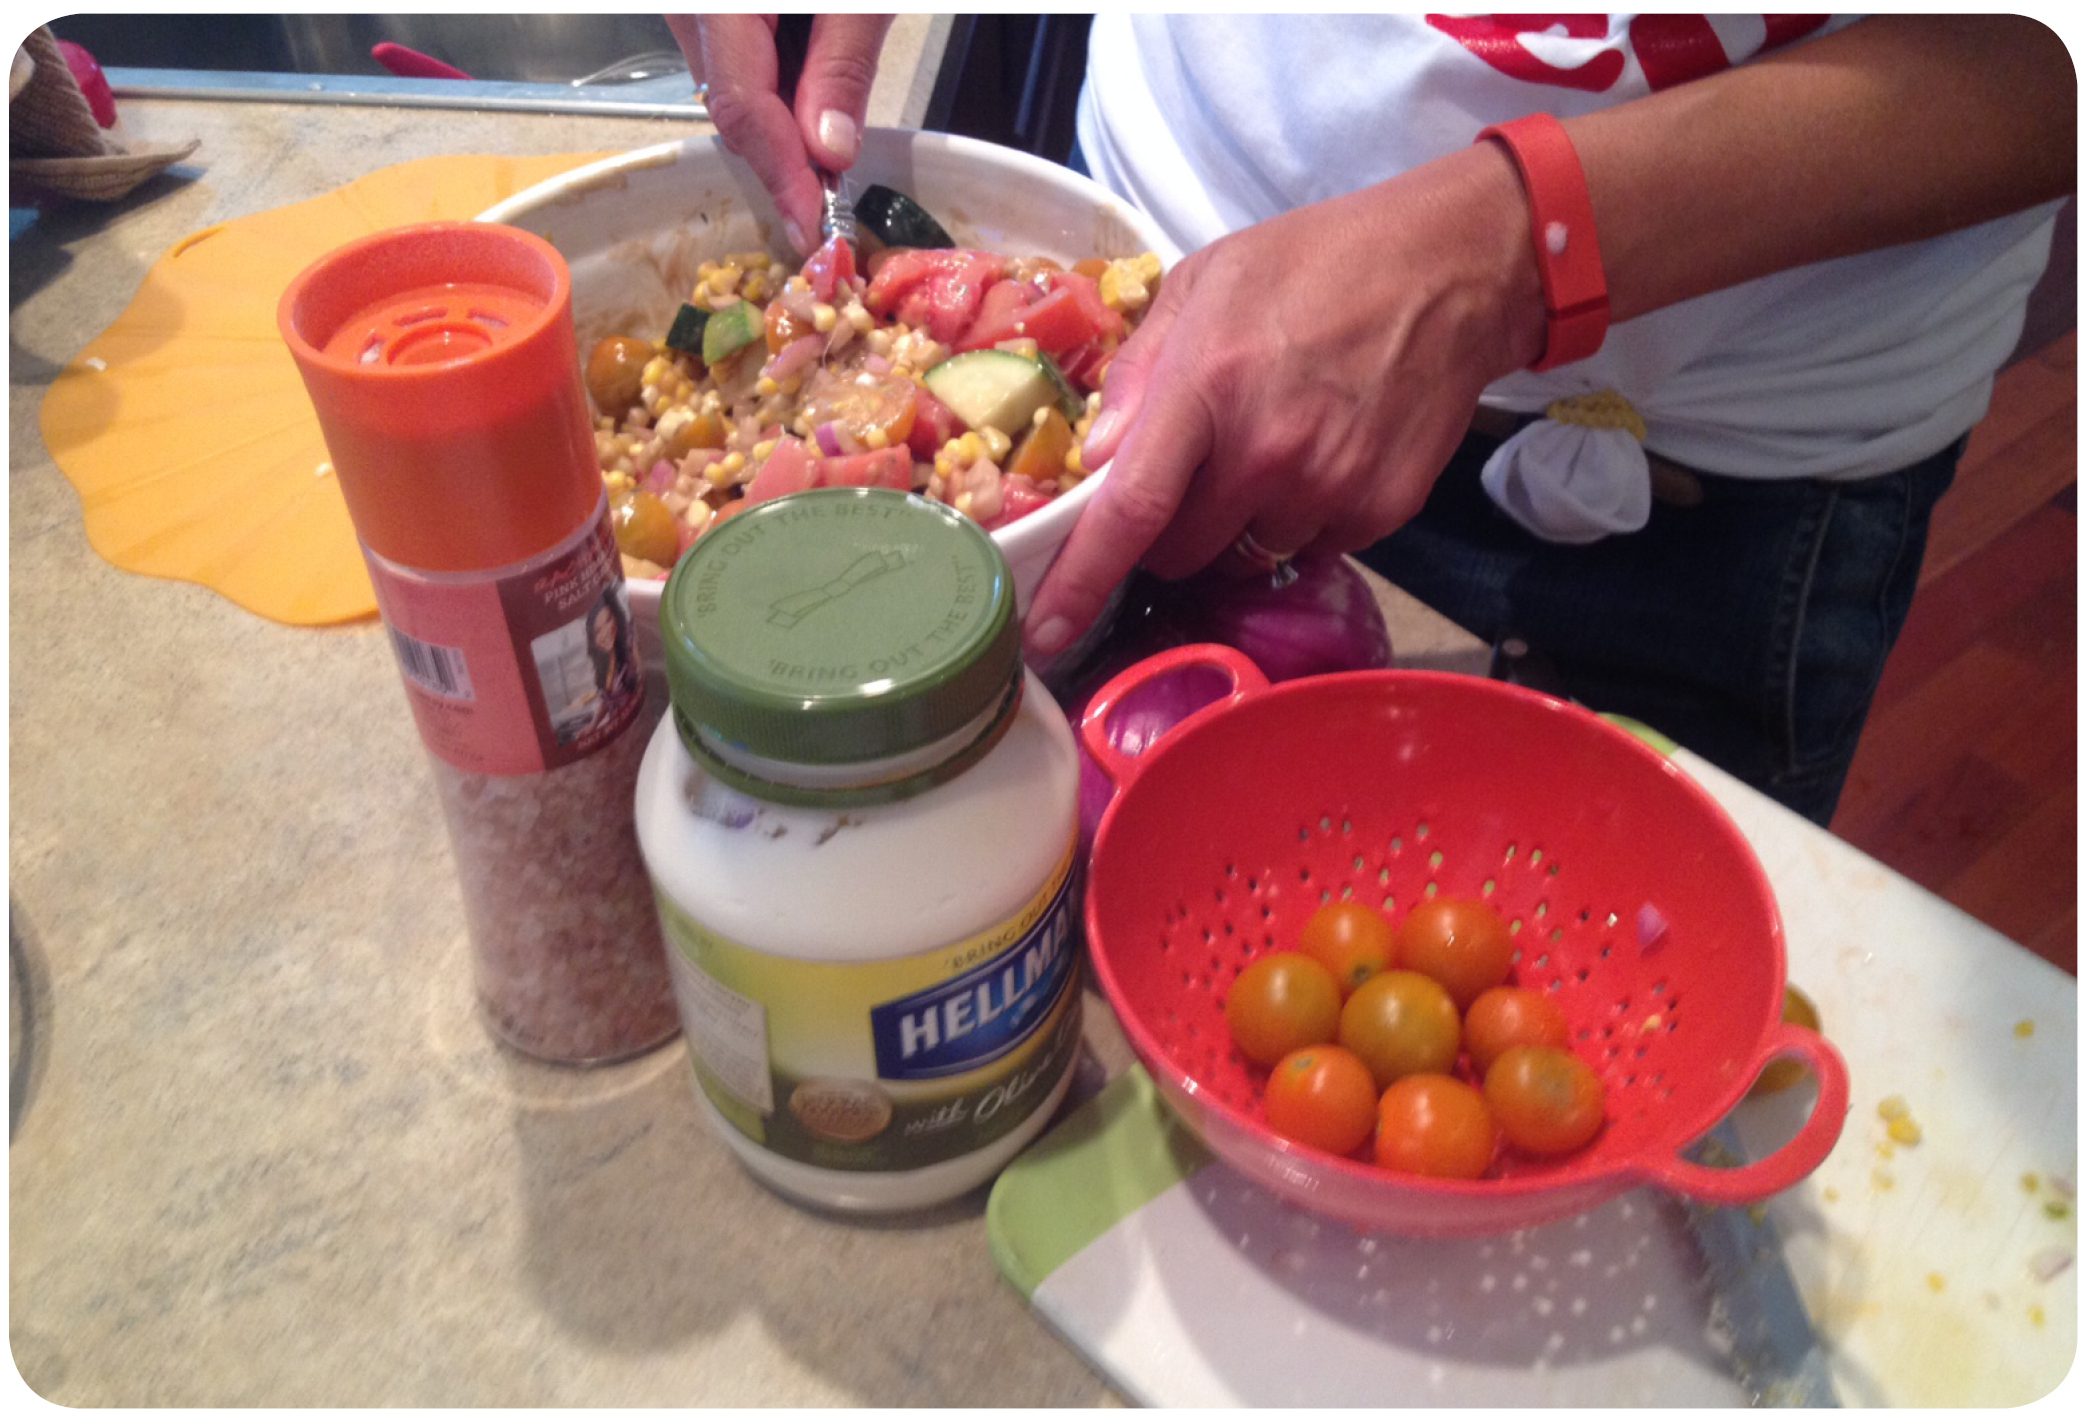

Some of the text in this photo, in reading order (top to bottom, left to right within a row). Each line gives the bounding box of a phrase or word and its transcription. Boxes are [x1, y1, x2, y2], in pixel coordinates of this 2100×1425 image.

[722, 522, 766, 555] OUT
[773, 504, 825, 526] THE
[544, 576, 578, 604] PINK
[558, 580, 591, 611] SALT
[868, 642, 925, 672] OUT
[926, 608, 967, 641] THE
[901, 903, 1073, 1060] HELLMA
[904, 1097, 969, 1136] with
